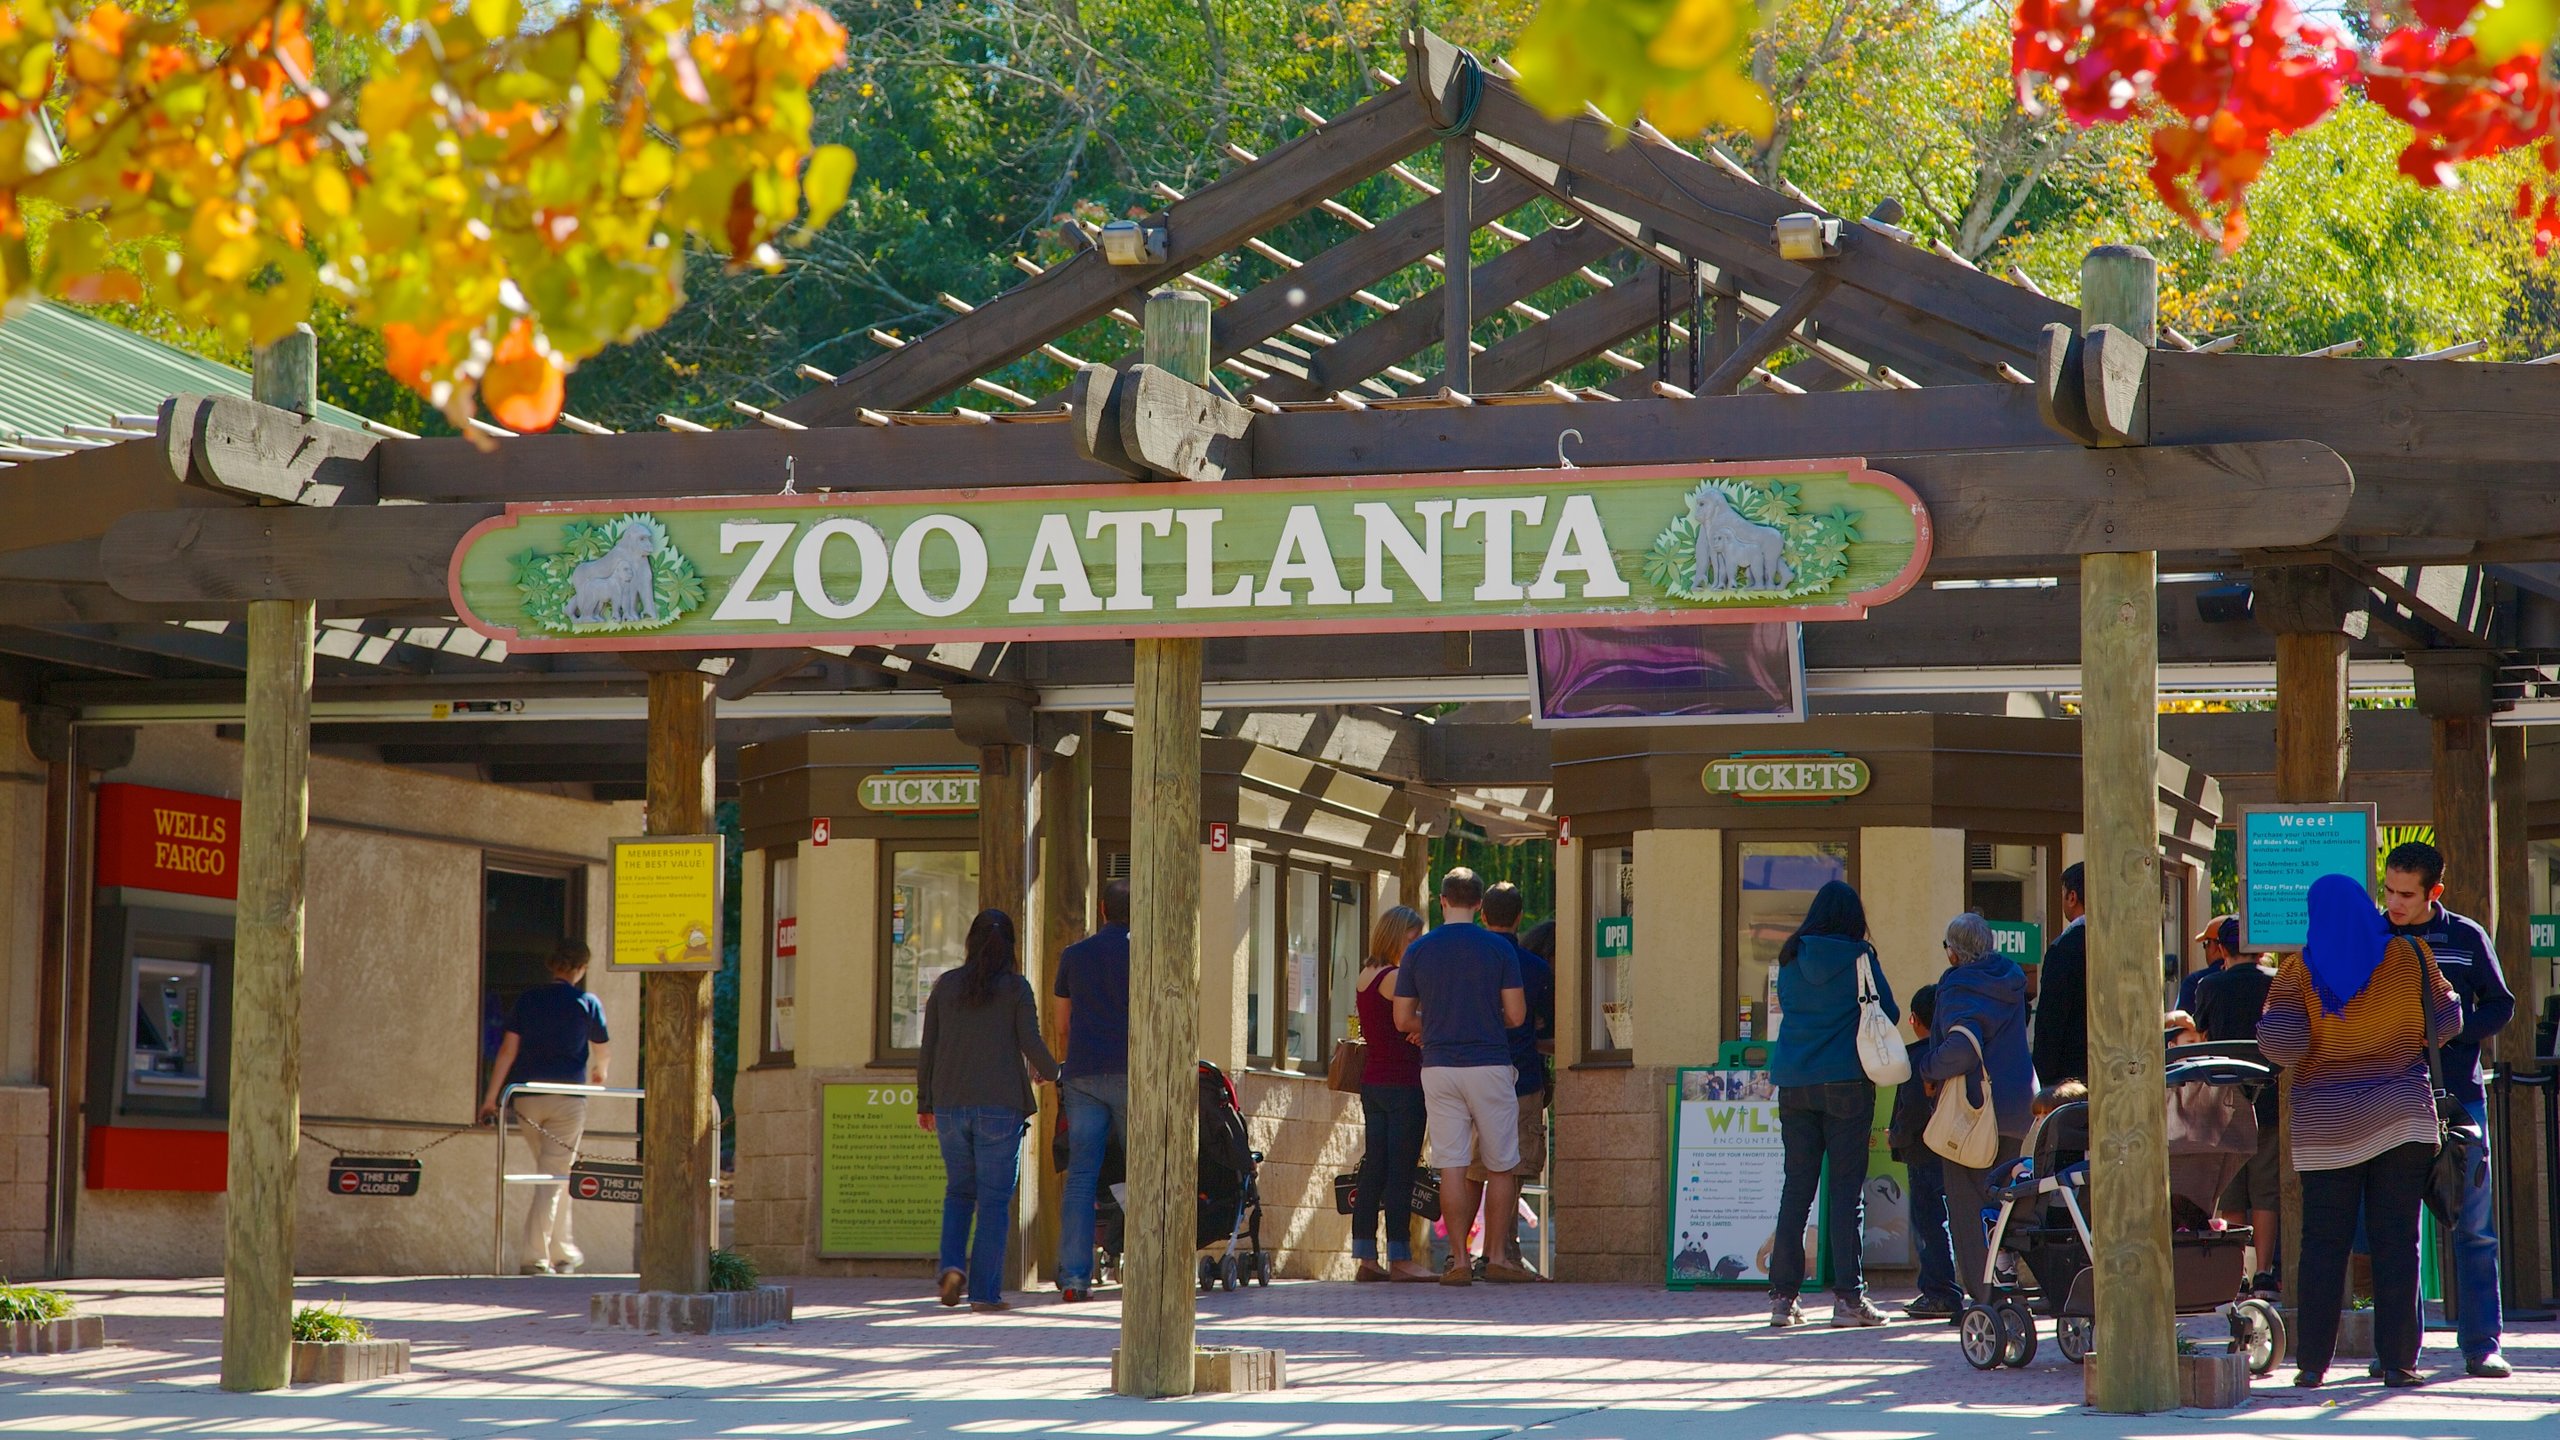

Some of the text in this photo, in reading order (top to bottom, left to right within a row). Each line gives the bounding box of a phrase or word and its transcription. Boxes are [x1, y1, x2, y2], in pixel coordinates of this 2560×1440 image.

[711, 494, 1631, 625] ZOO ATLANTA
[1713, 763, 1858, 791] TICKETS
[867, 778, 980, 805] TICKET
[153, 807, 226, 844] WELLS
[2279, 814, 2334, 827] Weee!
[814, 822, 827, 843] 6
[1211, 828, 1225, 848] 5
[1561, 821, 1569, 842] 4
[154, 841, 225, 875] FARGO
[627, 848, 703, 858] MEMBERSHIP IS
[624, 859, 705, 869] THE BEST VALUE!
[1605, 925, 1628, 948] OPEN
[866, 1089, 914, 1105] ZOO
[362, 1172, 409, 1183] THIS LINE
[602, 1177, 625, 1189] THIS
[360, 1183, 400, 1194] CLOSED
[600, 1189, 640, 1201] CLOSED
[1412, 1187, 1434, 1203] LINE
